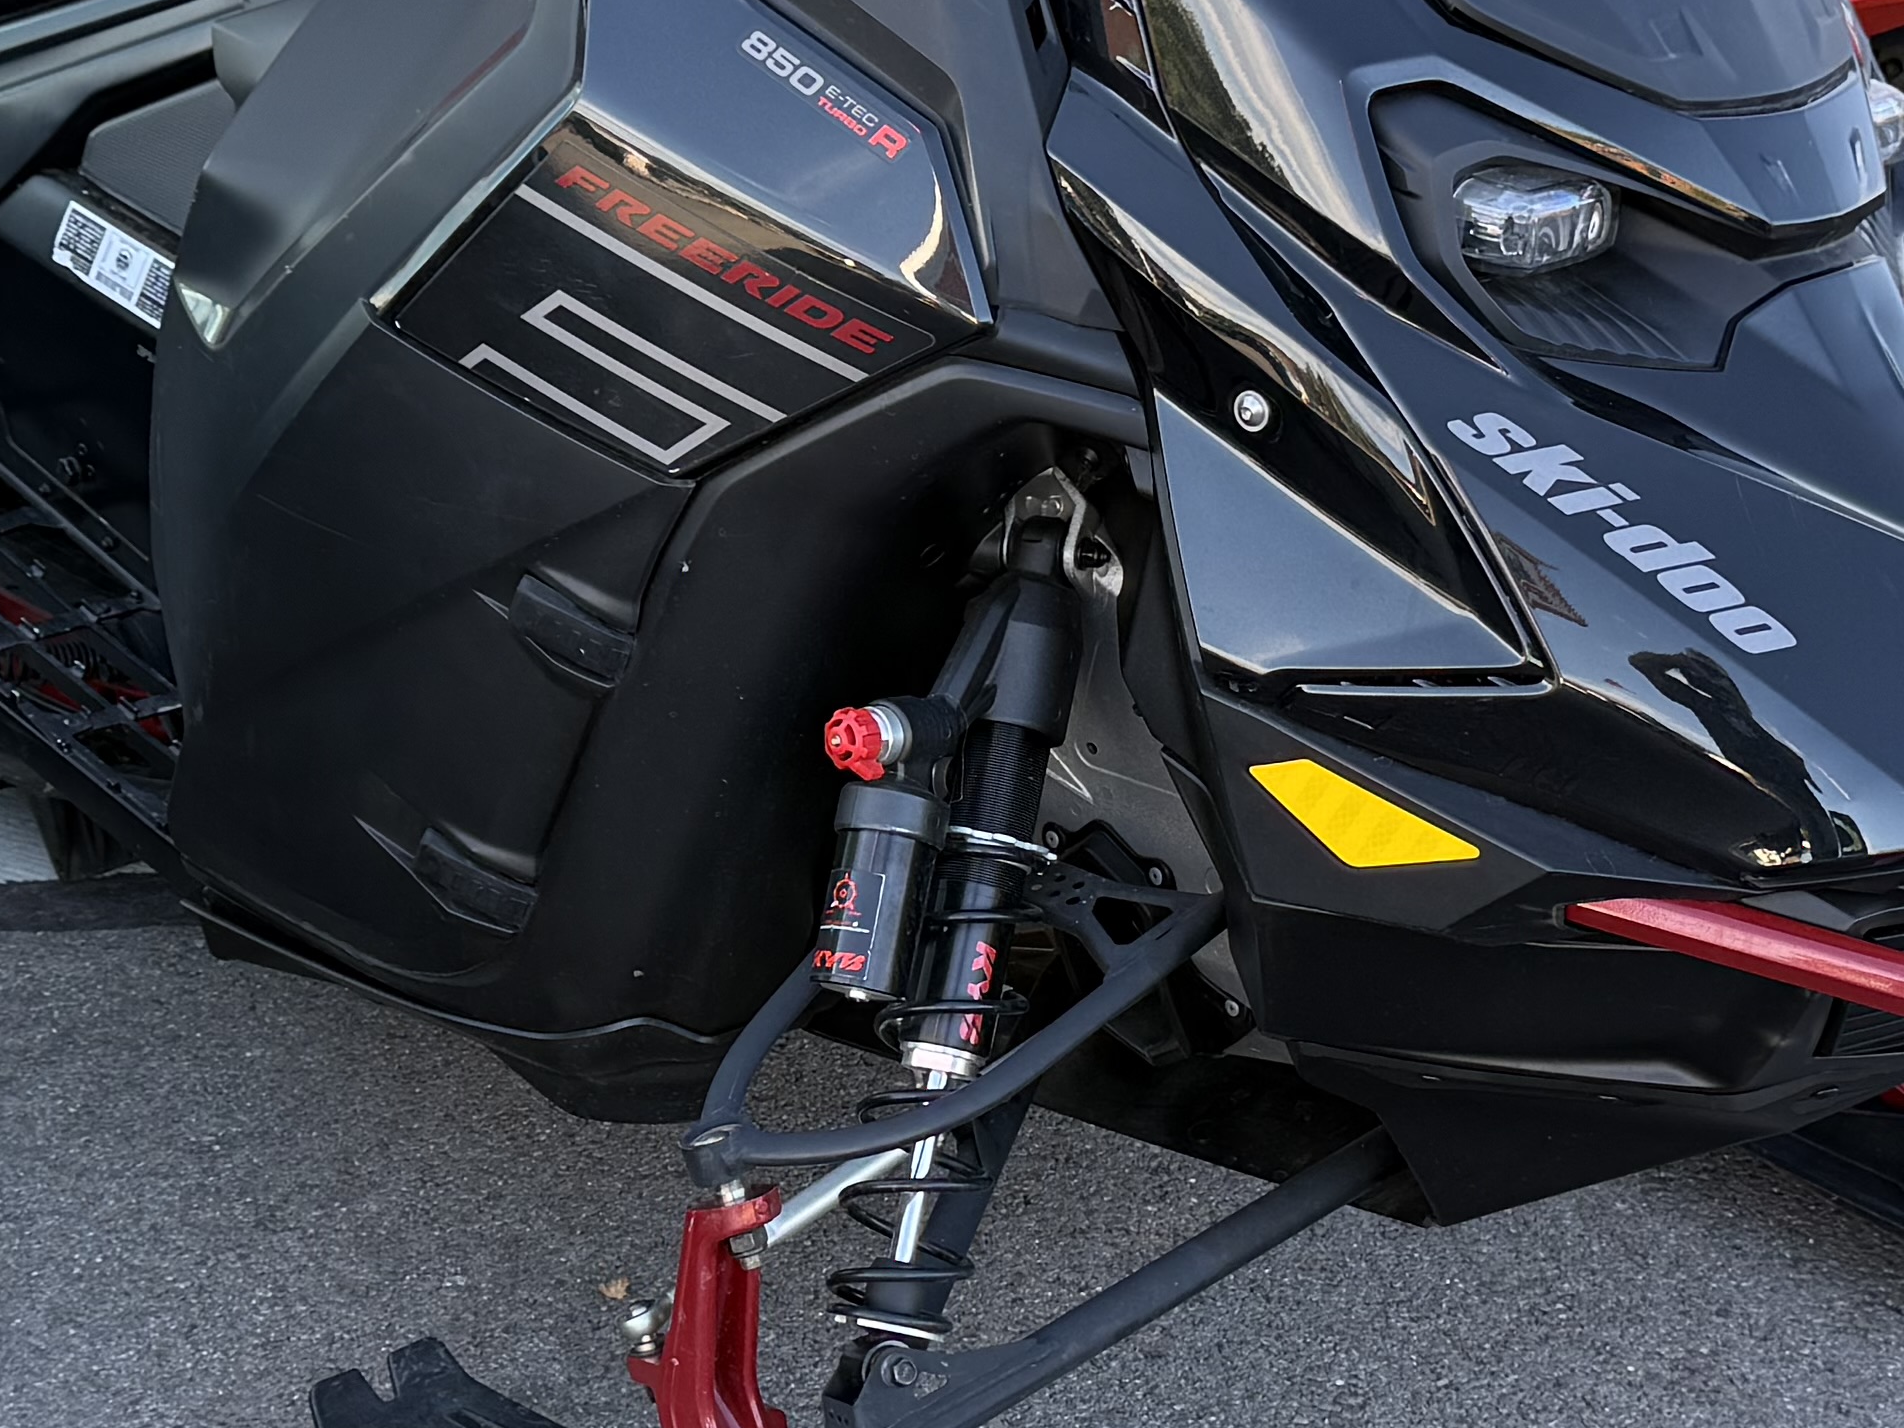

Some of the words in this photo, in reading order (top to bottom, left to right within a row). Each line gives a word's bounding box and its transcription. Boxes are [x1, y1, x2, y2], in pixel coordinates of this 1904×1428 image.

[741, 29, 824, 97] 850
[825, 84, 879, 128] E-TEC
[817, 95, 866, 138] TURBO
[869, 123, 908, 160] R
[556, 164, 894, 355] FREERIDE
[1447, 412, 1796, 654] ski-doo
